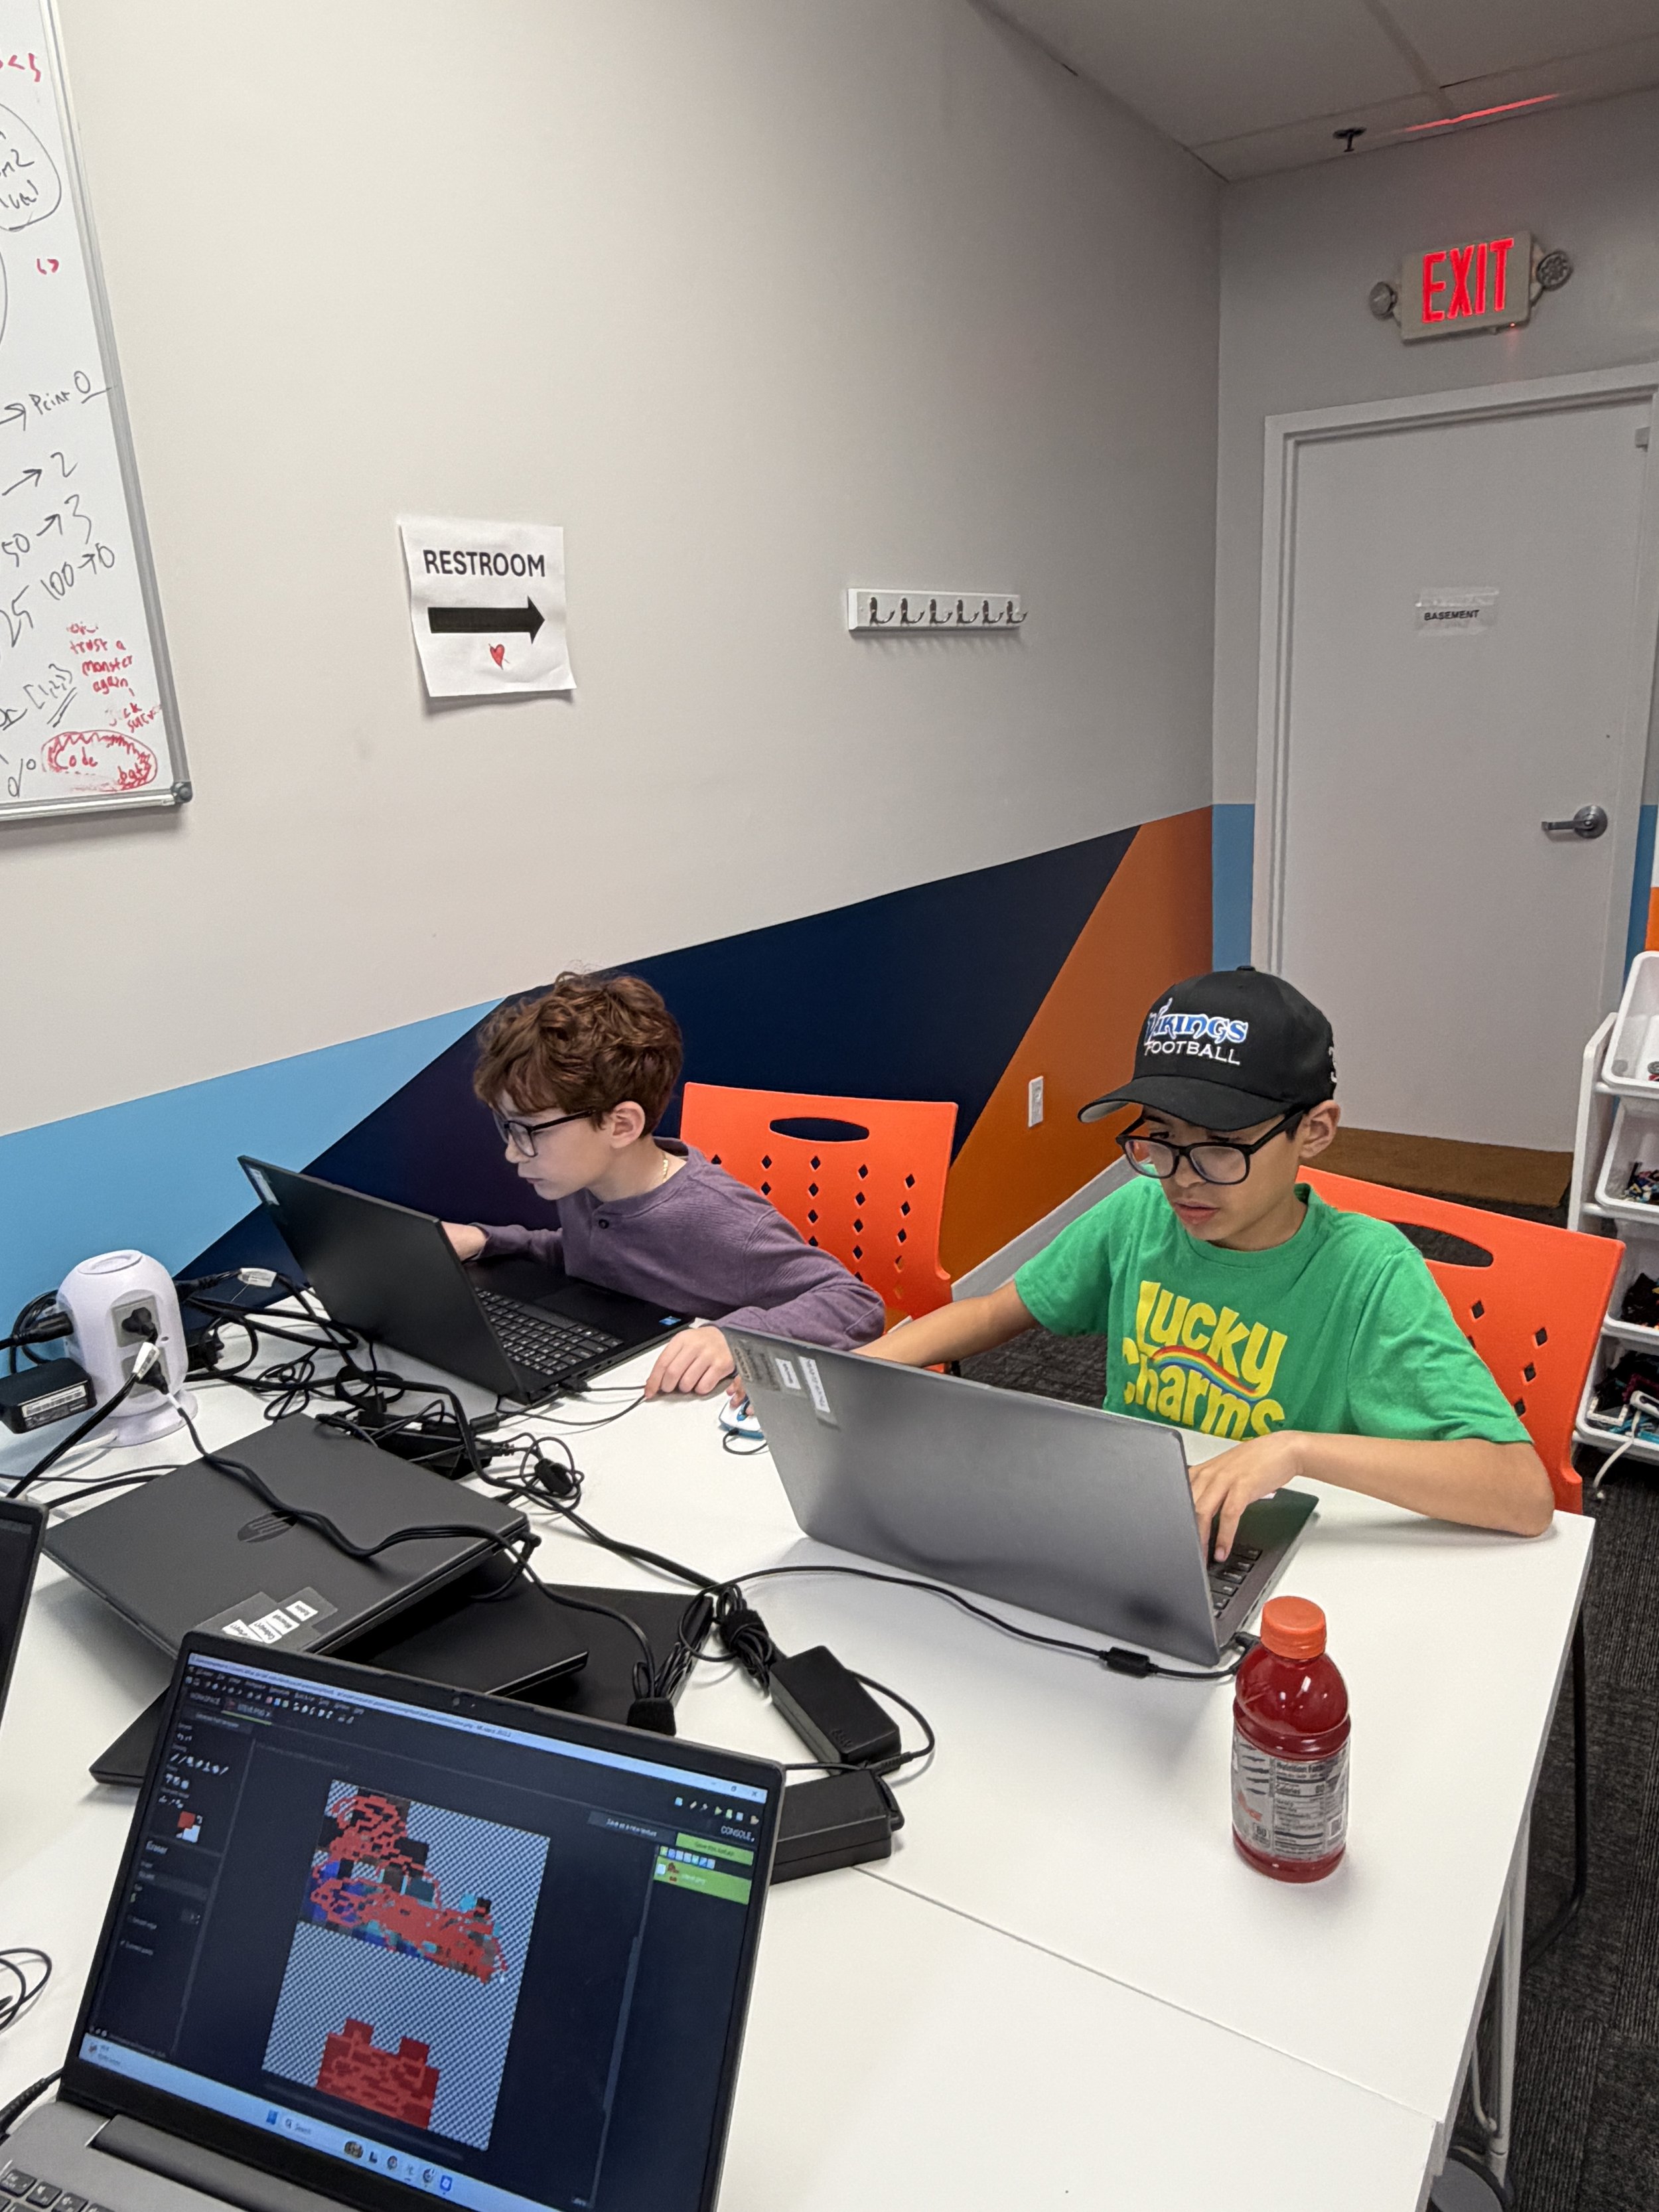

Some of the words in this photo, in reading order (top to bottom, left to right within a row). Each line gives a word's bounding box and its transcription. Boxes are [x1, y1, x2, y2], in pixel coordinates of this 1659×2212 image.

[1422, 237, 1514, 323] EXIT
[423, 548, 545, 577] RESTROOM
[1423, 609, 1480, 621] BASEMENT
[1143, 1039, 1241, 1066] FOOTBALL
